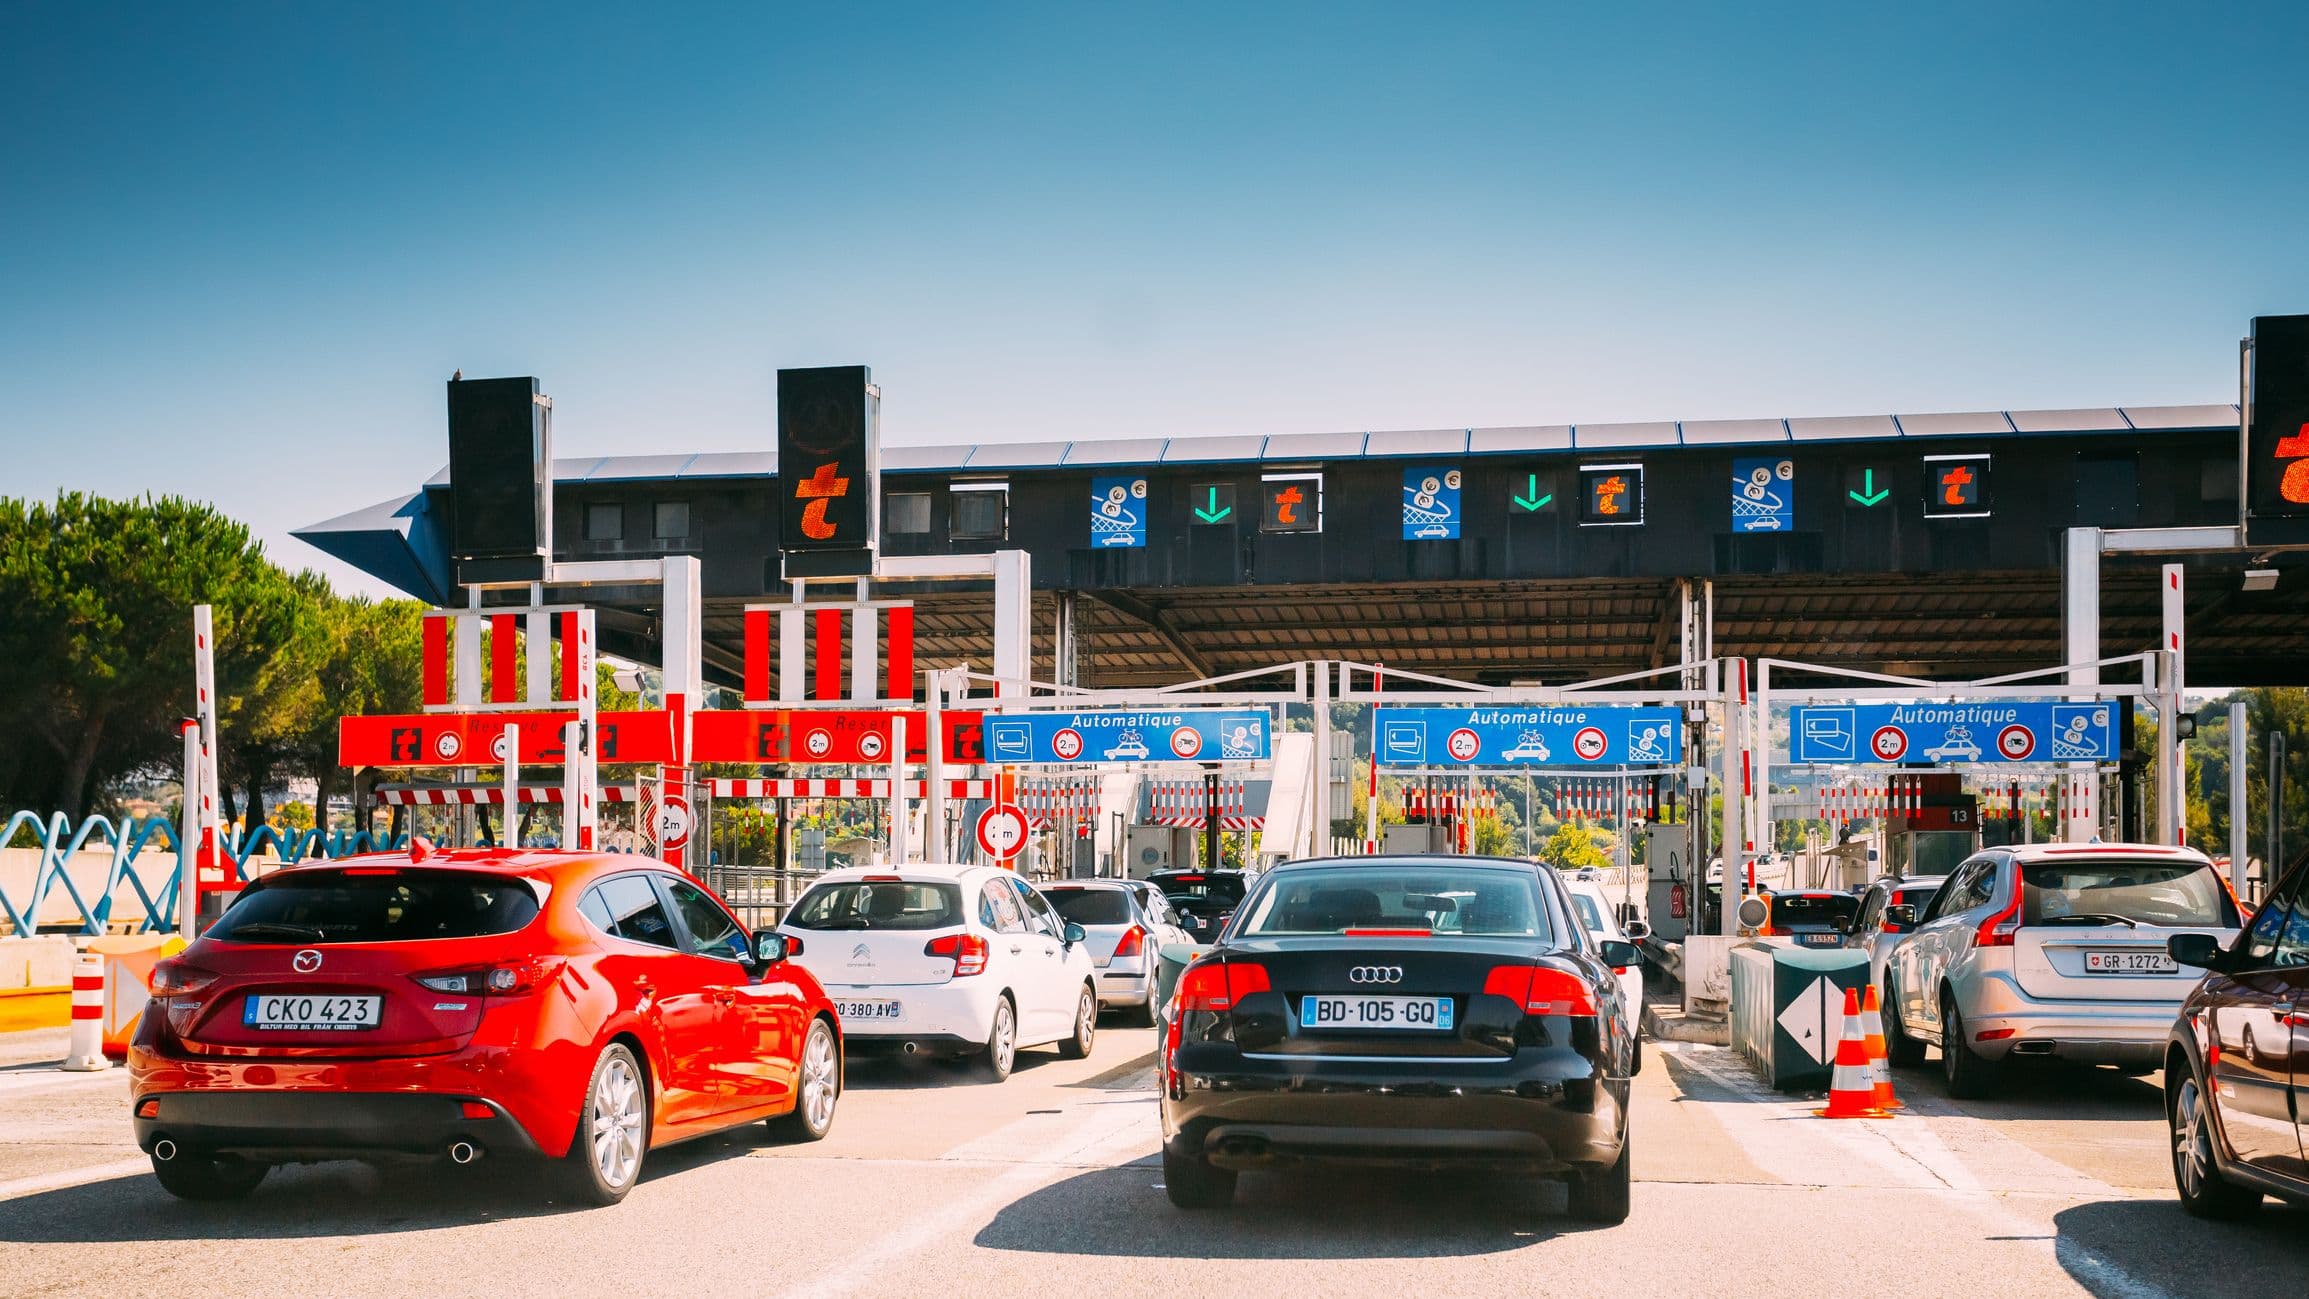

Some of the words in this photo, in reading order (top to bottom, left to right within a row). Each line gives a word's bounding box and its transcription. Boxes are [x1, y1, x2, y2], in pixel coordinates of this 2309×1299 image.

[1070, 713, 1182, 728] Automatique
[1467, 710, 1587, 726] Automatique
[1890, 705, 2017, 728] Automatique
[1952, 810, 1967, 822] 13
[266, 998, 312, 1021] CKO
[320, 999, 369, 1022] 423
